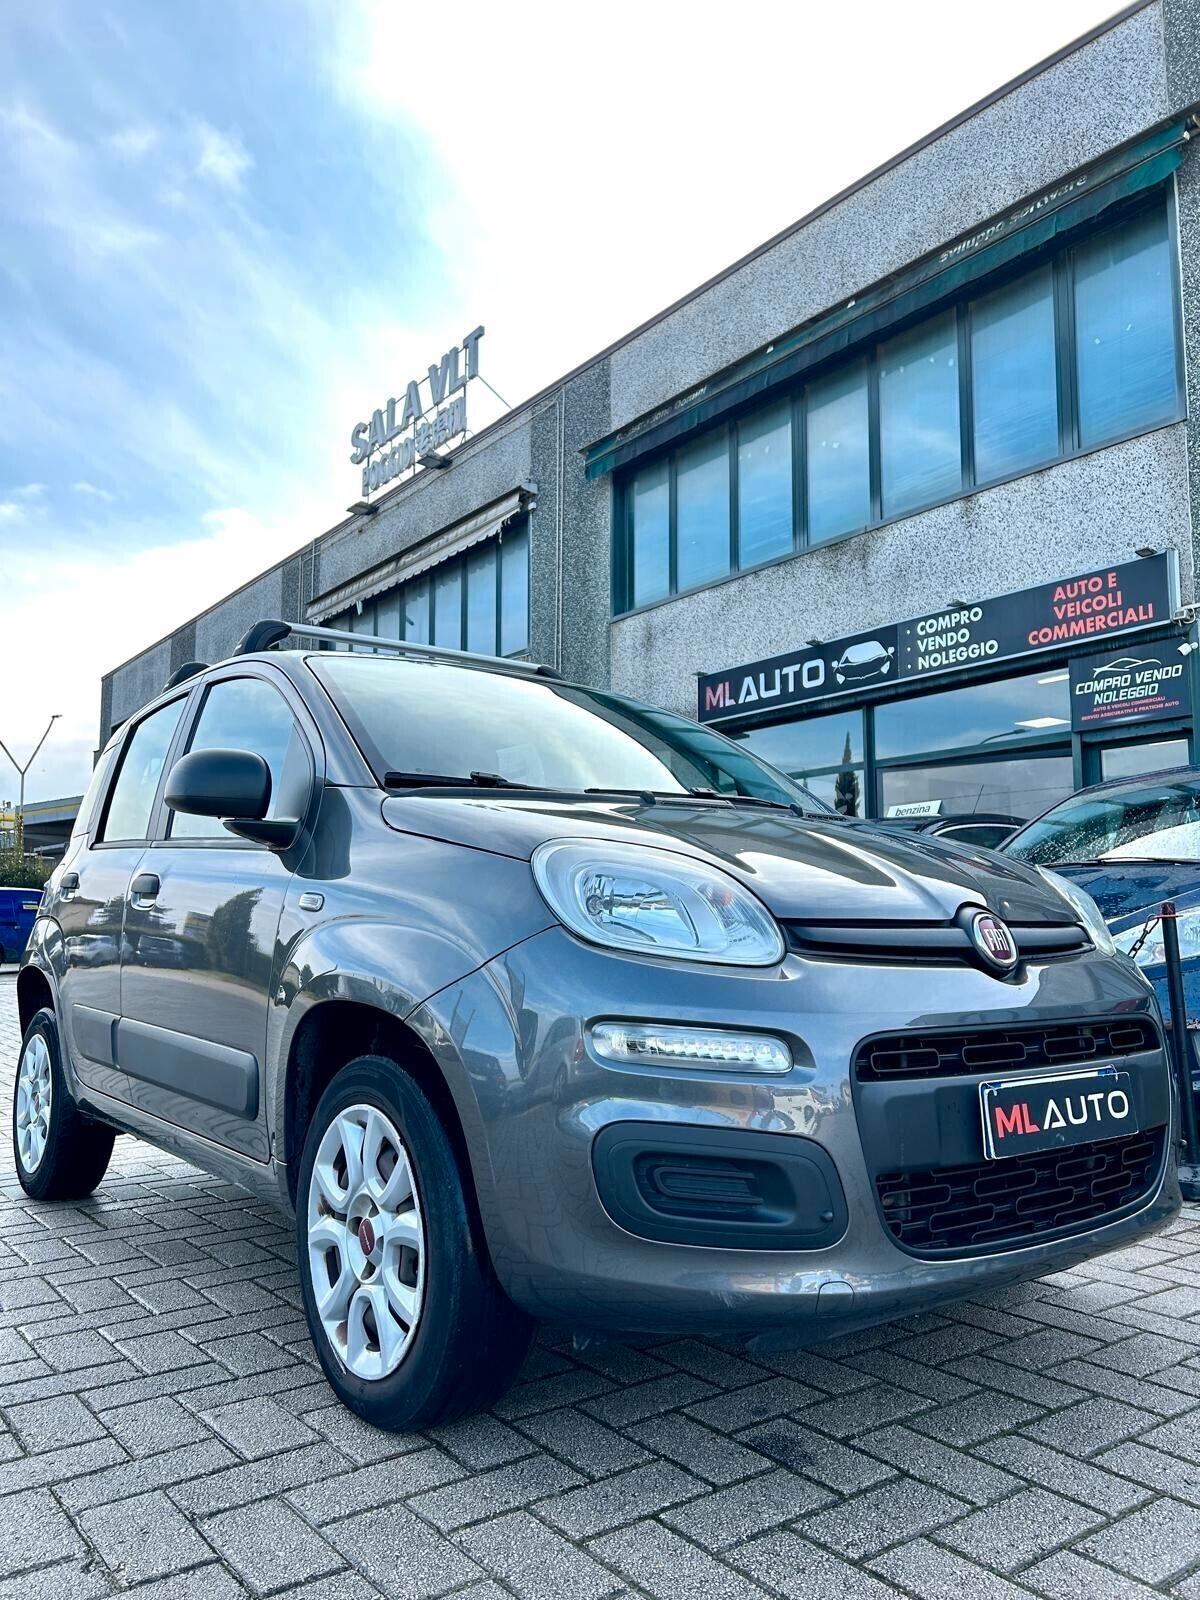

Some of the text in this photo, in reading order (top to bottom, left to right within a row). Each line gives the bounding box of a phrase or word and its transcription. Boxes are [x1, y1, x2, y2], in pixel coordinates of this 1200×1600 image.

[350, 325, 485, 465] SALA VLT
[1053, 572, 1117, 602] AUTO E
[1053, 591, 1122, 620] VEICOLI
[916, 606, 983, 636] COMPRO
[1028, 603, 1154, 645] COMMERCIALI
[917, 628, 970, 653] VENDO
[918, 639, 999, 670] NOLEGGIO
[1075, 664, 1183, 695] COMPRO VENDO
[1093, 683, 1159, 705] NOLEGGIO
[1100, 708, 1134, 718] ASSICURATIVI
[1138, 703, 1164, 712] PRATICHE
[1131, 696, 1165, 706] COMMERCIALI
[895, 805, 931, 816] benzina
[983, 928, 1010, 951] FIAT
